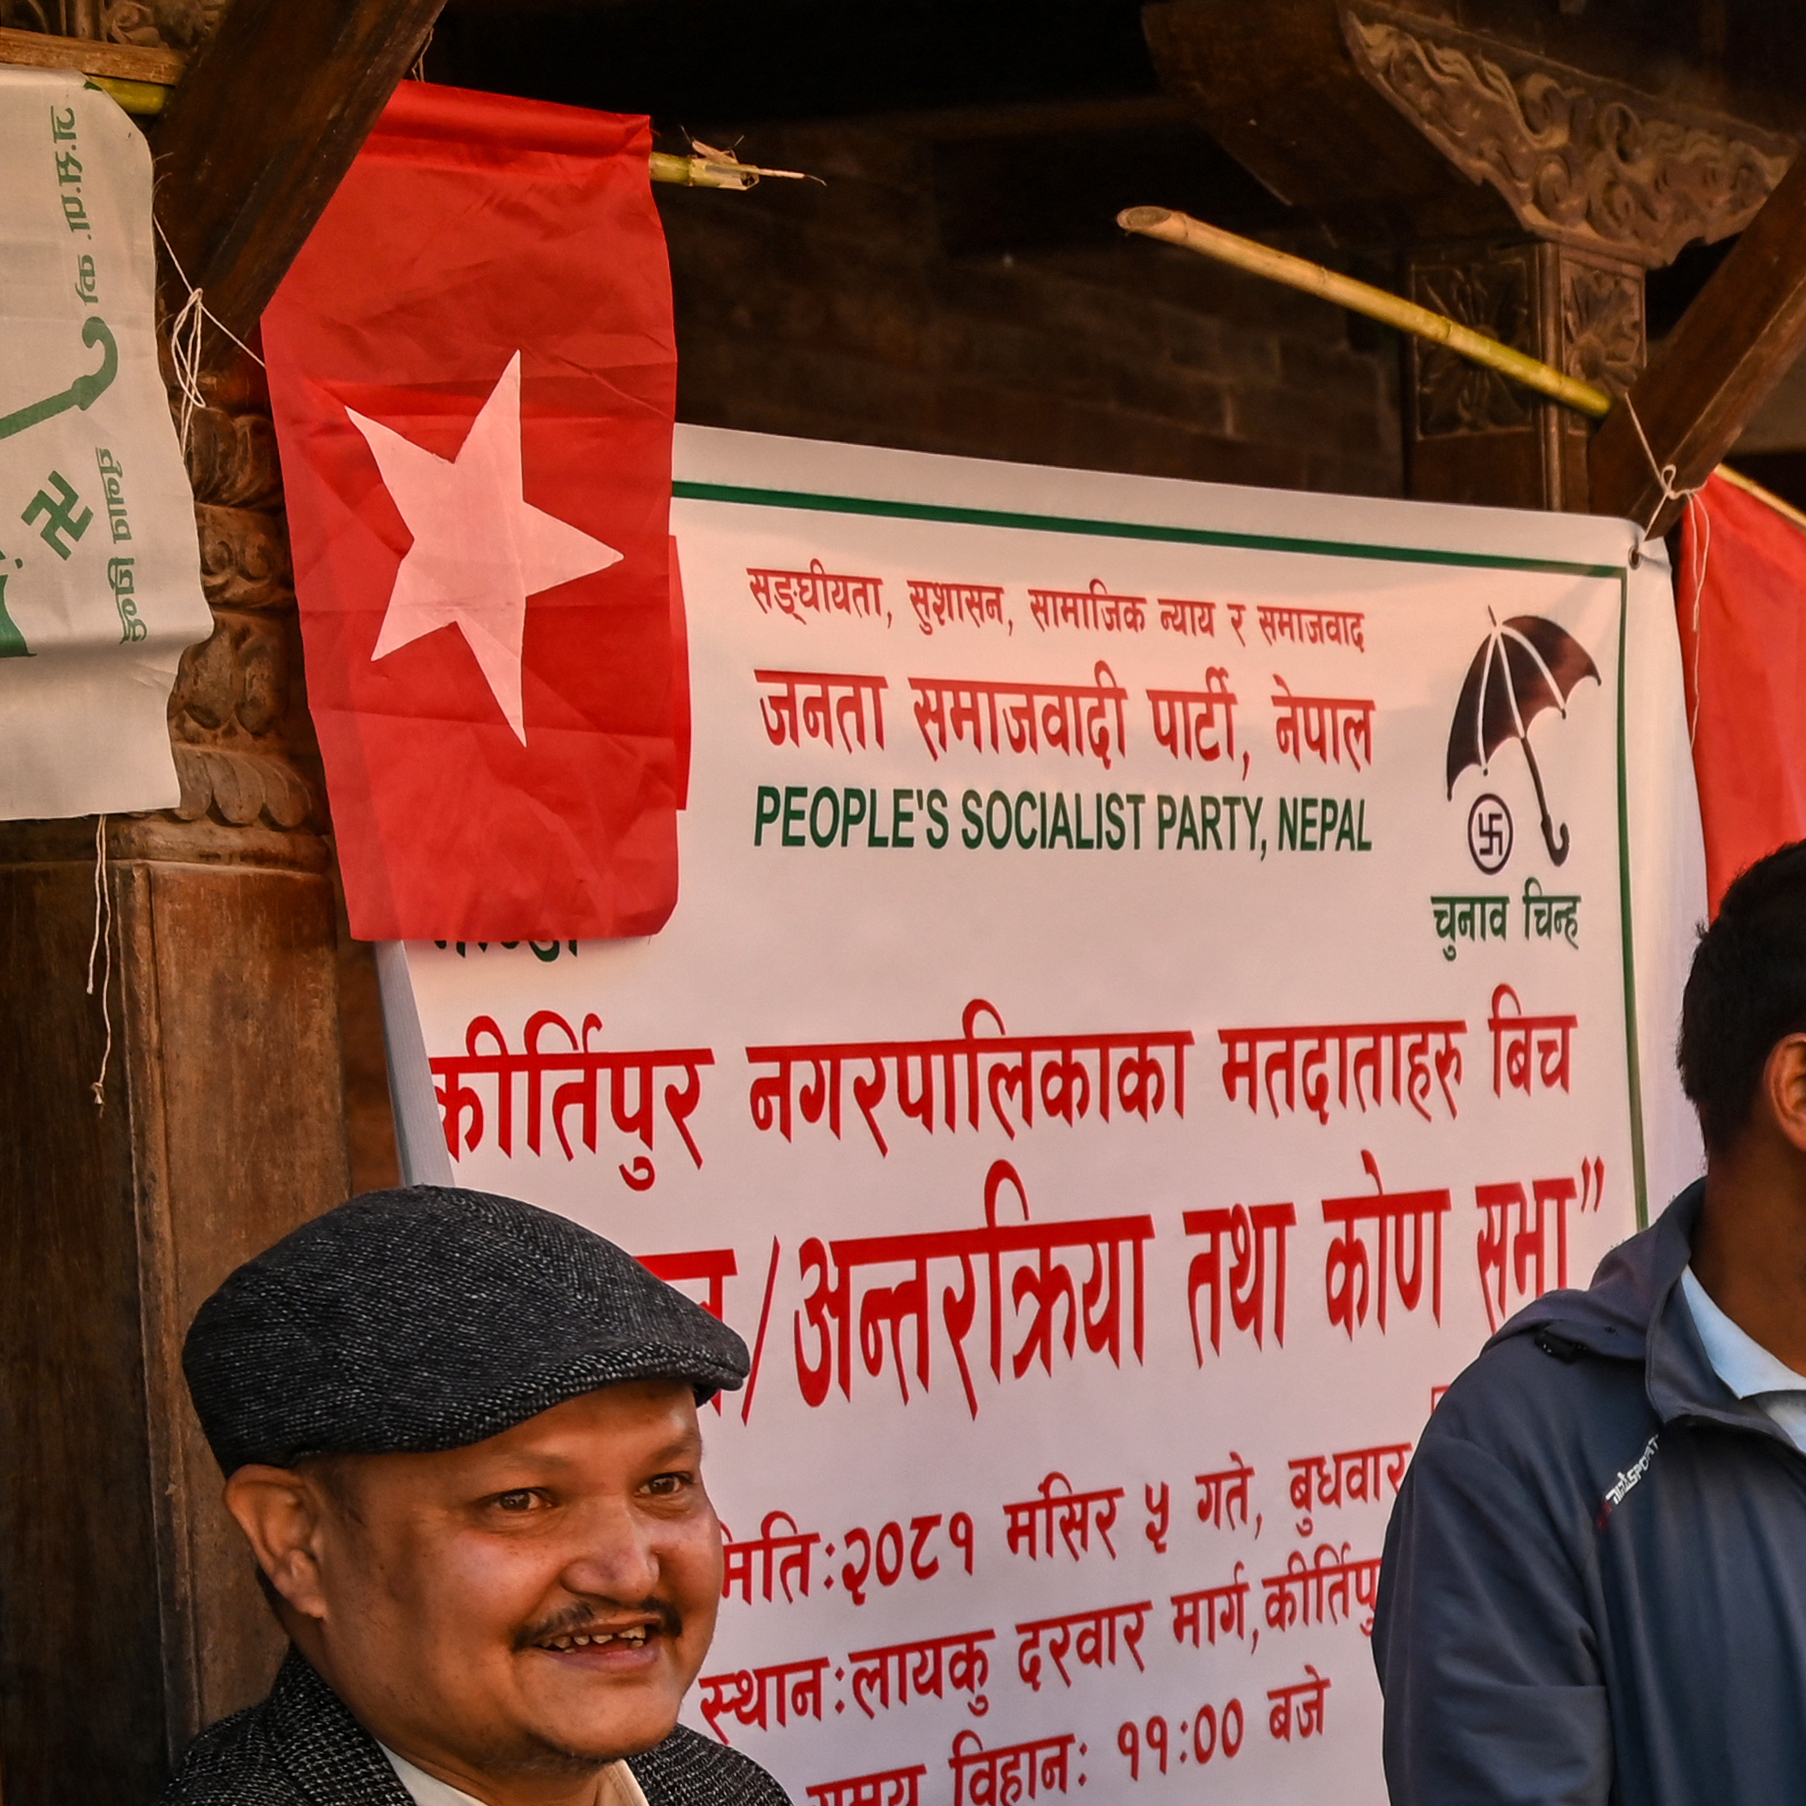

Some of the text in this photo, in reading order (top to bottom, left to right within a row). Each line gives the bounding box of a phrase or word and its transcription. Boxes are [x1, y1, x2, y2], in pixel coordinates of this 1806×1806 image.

[906, 579, 1014, 636] सुशासन,
[1027, 578, 1148, 633] सामाजिक
[1157, 598, 1217, 637] न्याय
[1226, 603, 1247, 647] र
[1256, 605, 1365, 654] समाजवाद
[753, 660, 1376, 781] जनता समाजवादी पार्टी, नेपाल
[754, 785, 1372, 862] PEOPLE'S SOCIALIST PARTY, NEPAL
[1430, 876, 1582, 962] चुनाव चिन्ह
[428, 1010, 716, 1191] कीर्तिपुर
[745, 998, 1195, 1163] नगरपालिकाका
[1487, 983, 1578, 1098] बिच
[1182, 1202, 1297, 1369] तथा
[1321, 1149, 1452, 1341] कोण
[1145, 1481, 1169, 1554] ५
[1194, 1451, 1263, 1539] गते,
[1287, 1442, 1413, 1537] बुधवार
[1015, 1600, 1153, 1692] दरवार
[1117, 1698, 1244, 1782] ११:००
[1266, 1664, 1331, 1743] बजे
